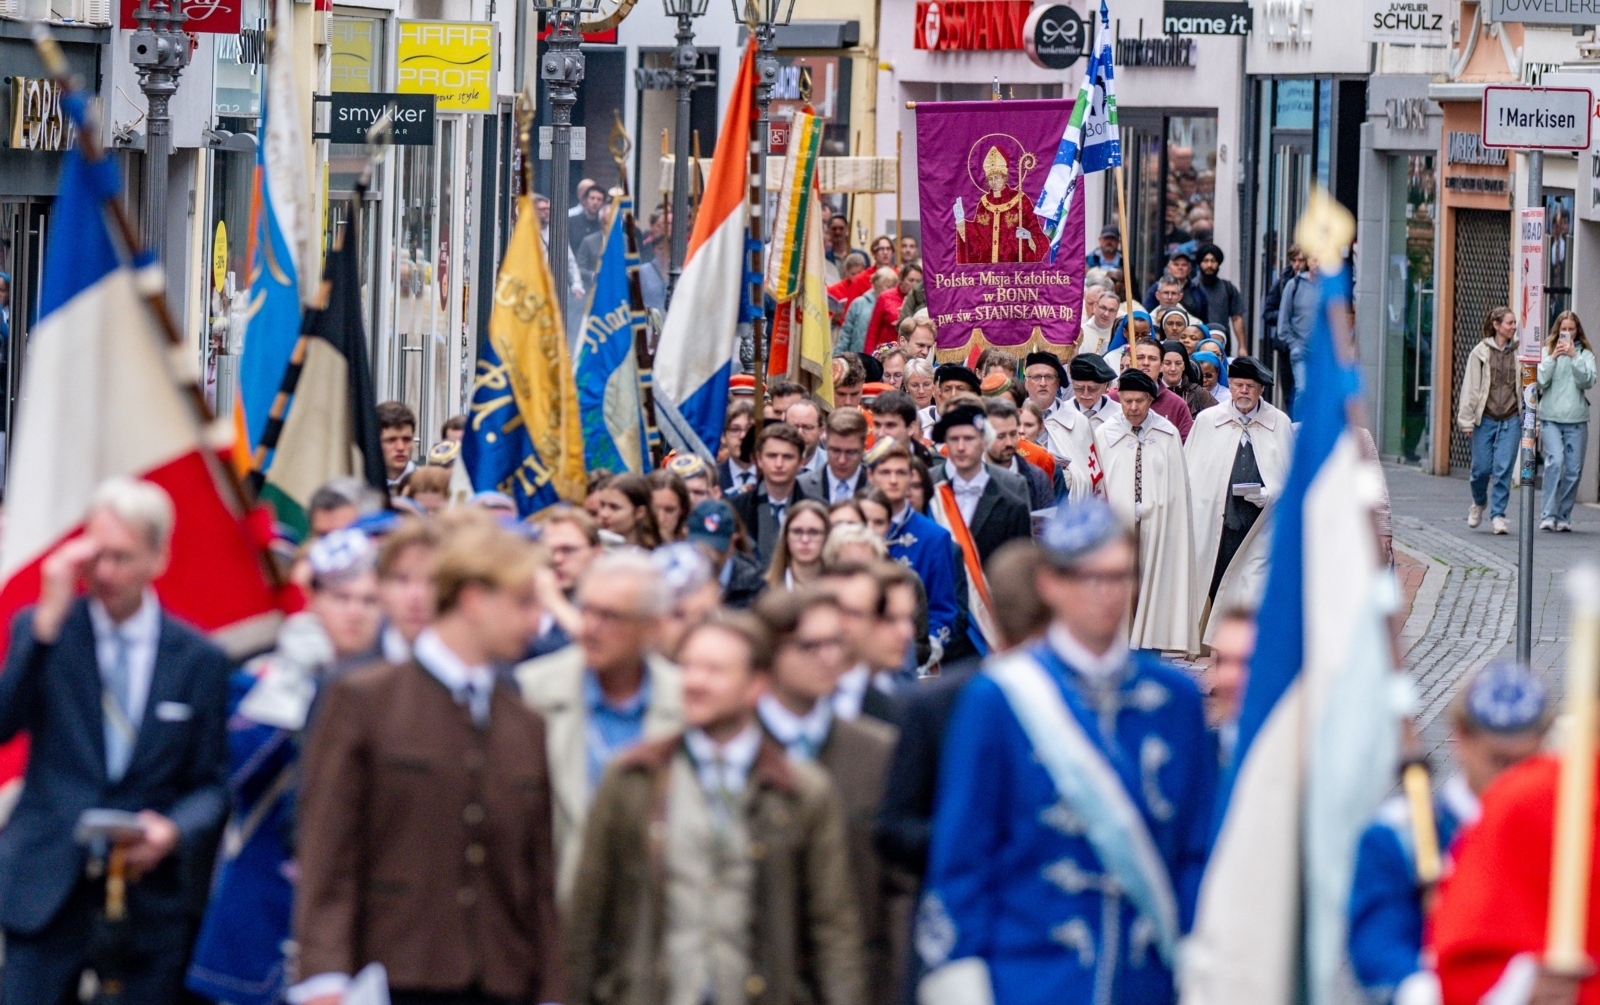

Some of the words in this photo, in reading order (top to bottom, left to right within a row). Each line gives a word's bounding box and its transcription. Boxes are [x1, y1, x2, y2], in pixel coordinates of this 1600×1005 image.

[1388, 2, 1428, 12] JUWELIER
[914, 0, 1031, 51] ROSSMANN
[1164, 16, 1226, 34] name
[1229, 14, 1247, 34] it
[1373, 13, 1443, 31] SCHULZ
[399, 25, 491, 46] HAAR
[397, 67, 491, 89] PROFI
[458, 88, 480, 104] style
[338, 104, 427, 125] smykker
[935, 272, 975, 289] Polska
[978, 270, 1011, 287] Misja
[1014, 270, 1071, 285] Katolicka
[983, 293, 994, 303] w
[997, 287, 1039, 302] BONN
[974, 304, 1056, 320] STANISŁAWA
